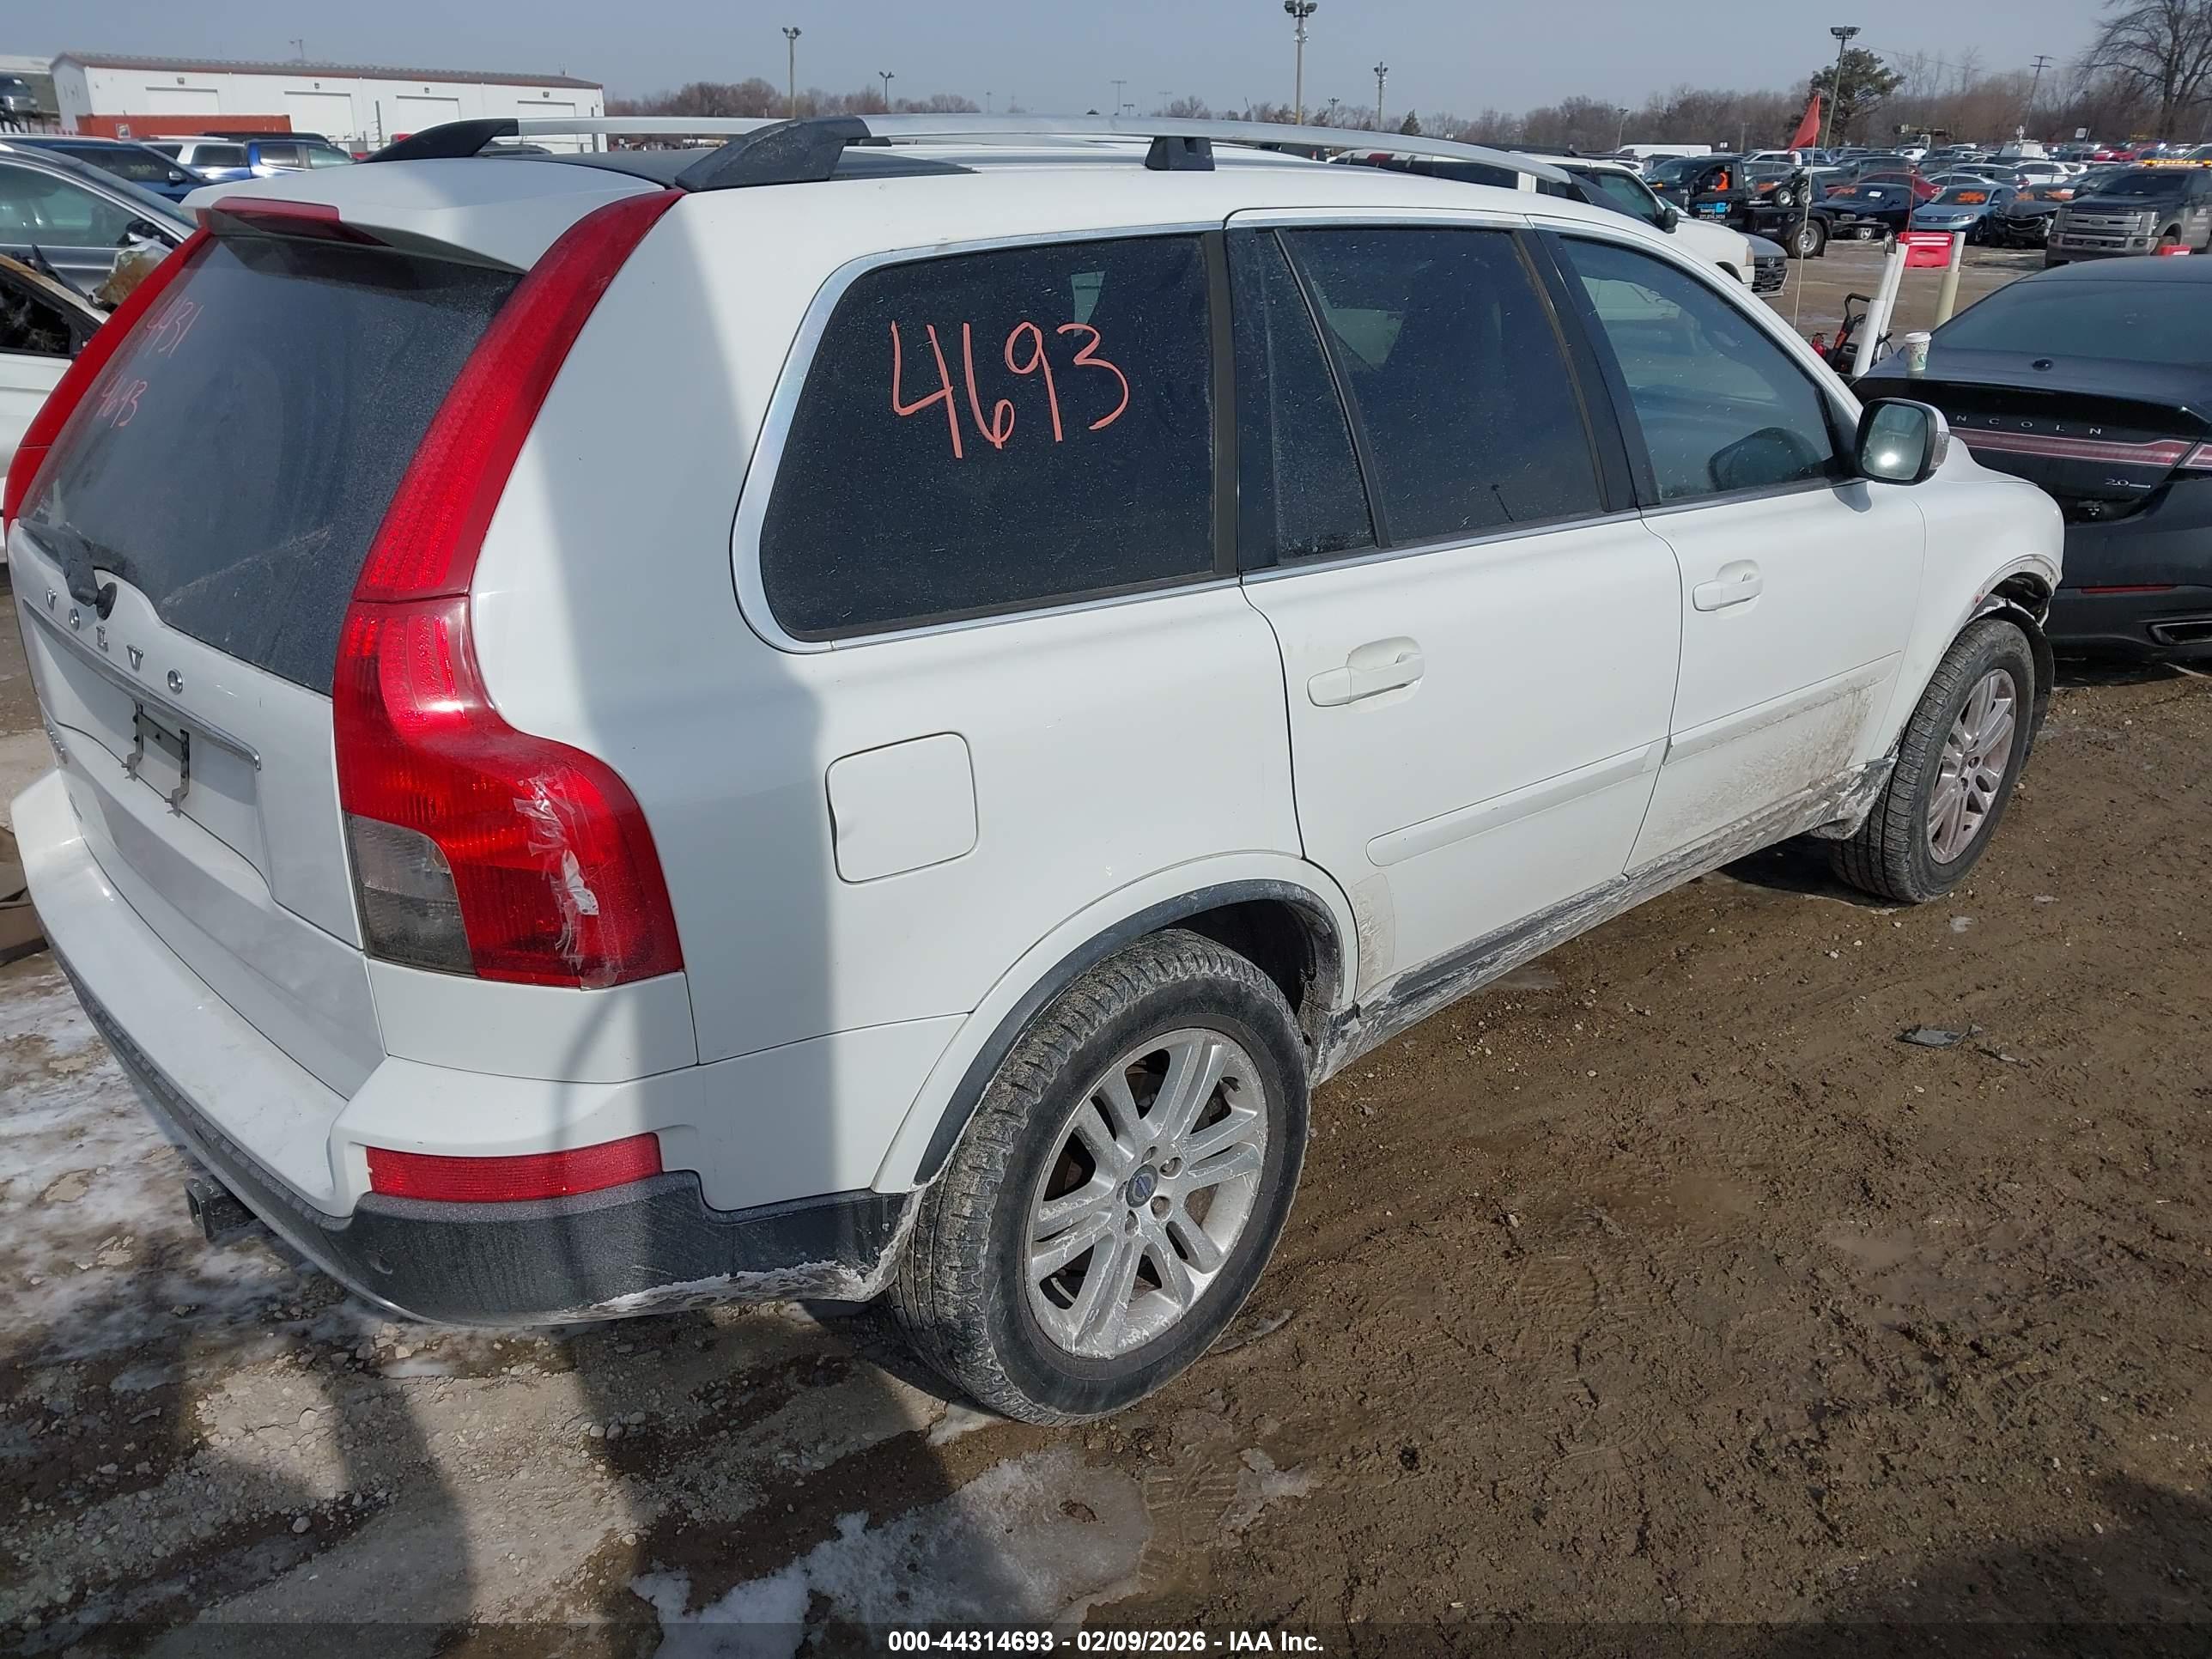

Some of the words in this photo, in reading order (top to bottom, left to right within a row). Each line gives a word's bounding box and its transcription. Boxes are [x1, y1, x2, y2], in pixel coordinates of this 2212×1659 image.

[891, 319, 1129, 459] 4693
[1955, 414, 2102, 435] NCOLN
[45, 586, 184, 695] VOLVO
